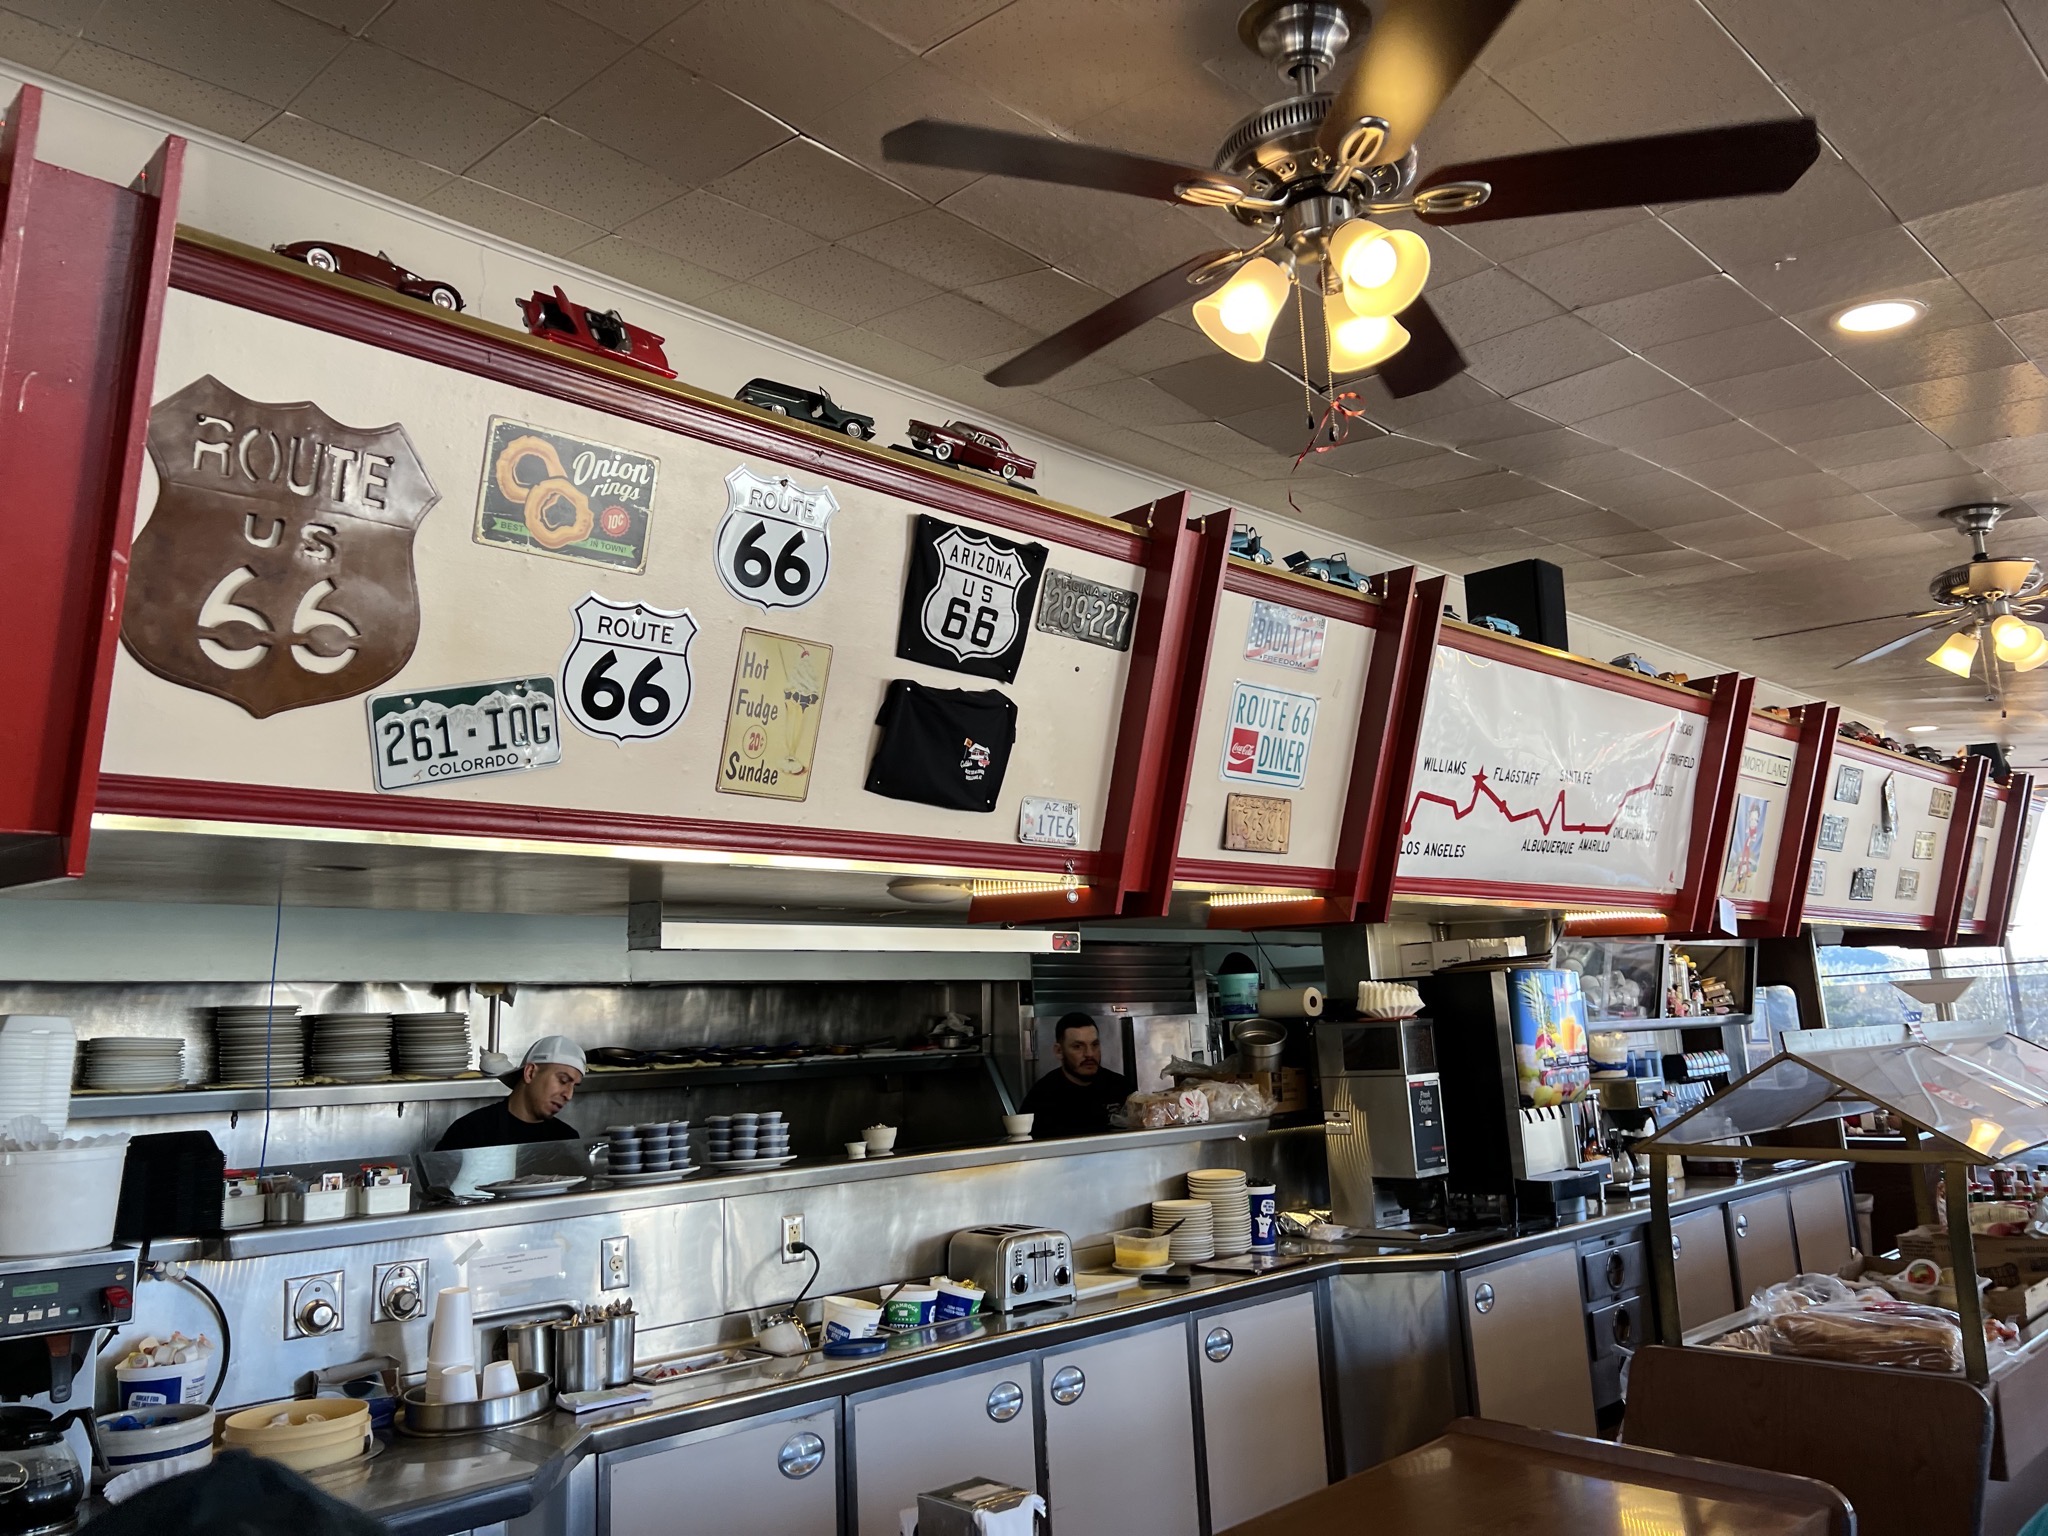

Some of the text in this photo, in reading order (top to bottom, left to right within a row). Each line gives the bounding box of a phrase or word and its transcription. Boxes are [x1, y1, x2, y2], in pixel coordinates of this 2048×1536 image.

[193, 414, 394, 511] ROUTE
[572, 450, 651, 486] Onion
[590, 479, 640, 502] rings
[749, 488, 817, 521] ROUTE
[500, 521, 525, 533] BEST
[590, 540, 599, 549] IN
[733, 519, 811, 597] 66
[949, 544, 1012, 581] ARIZONA
[1054, 577, 1101, 598] VIRGINIA
[197, 563, 361, 675] 66
[597, 615, 675, 645] ROUTE
[940, 596, 999, 648] 66
[1254, 617, 1318, 660] BADATTY
[742, 651, 769, 681] Hot
[1262, 654, 1303, 668] FREEDOM
[580, 648, 671, 726] 66
[735, 688, 779, 726] Fudge
[1235, 692, 1311, 736] ROUTE 66
[427, 752, 519, 777] COLORADO
[1258, 735, 1305, 773] DINER
[1423, 756, 1468, 776] WILLIAMS
[725, 750, 779, 786] Sundae
[1493, 766, 1541, 786] FLAGSTAFF
[1582, 771, 1593, 785] FE
[1044, 802, 1060, 812] AZ
[1035, 814, 1074, 839] 17E6
[1423, 842, 1467, 858] ANGELES
[1520, 839, 1575, 856] ALBUQUERQUE
[1578, 838, 1611, 853] AMARILLO
[889, 1302, 919, 1314] SHAMROCK
